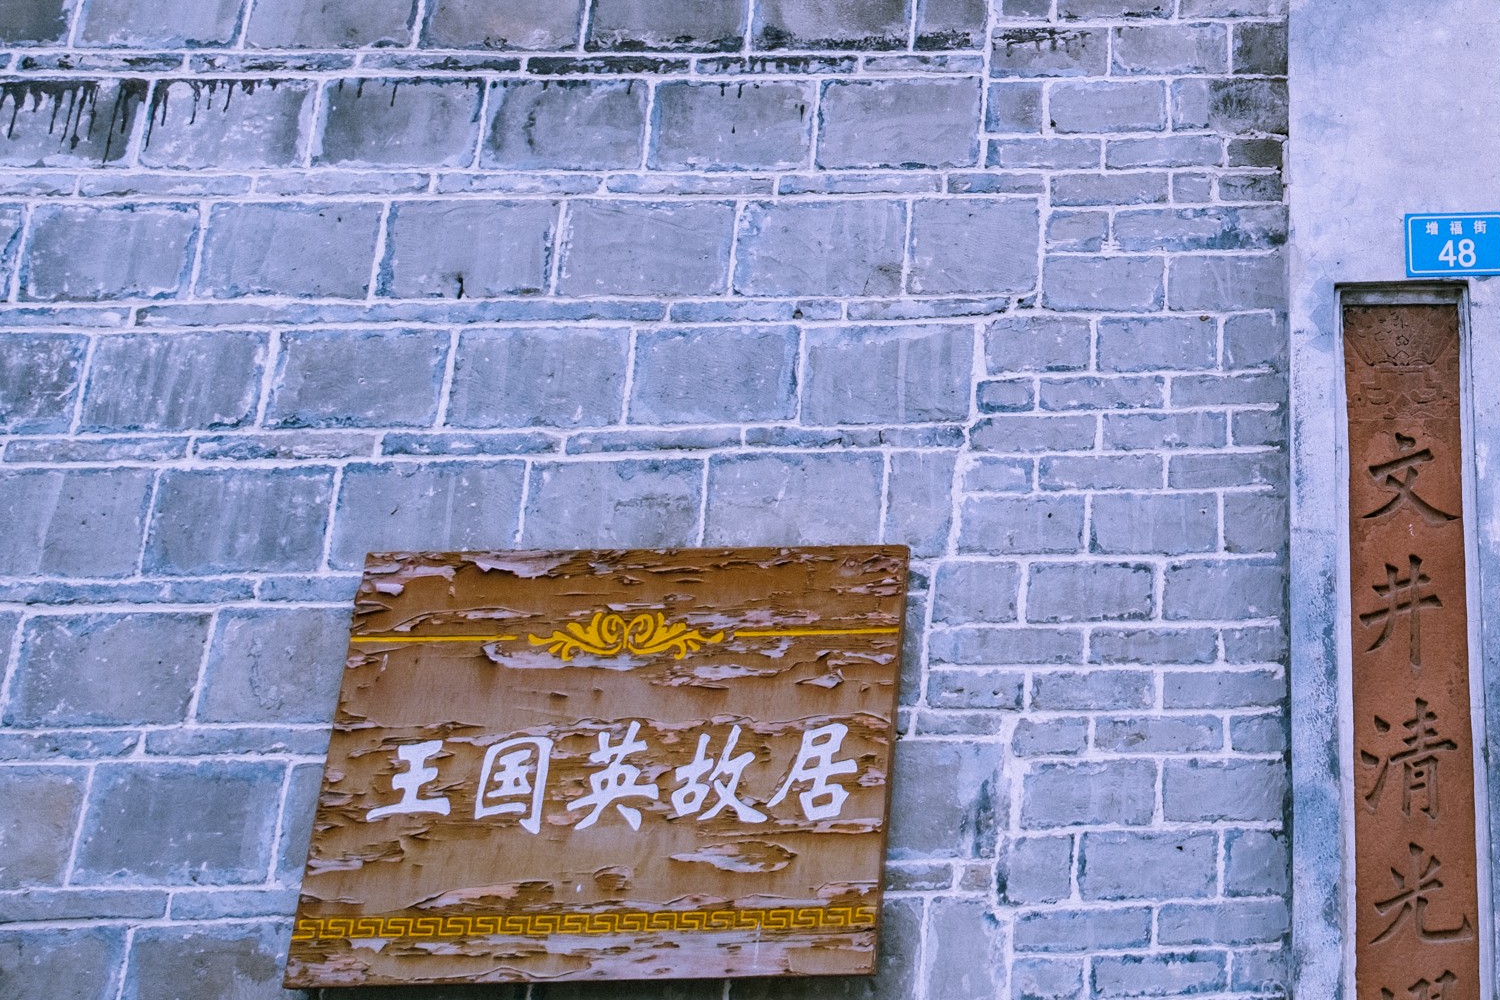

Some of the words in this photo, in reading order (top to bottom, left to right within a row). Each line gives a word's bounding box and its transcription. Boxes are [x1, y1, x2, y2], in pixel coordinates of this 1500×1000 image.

[1425, 220, 1487, 235] 增福街
[1438, 239, 1477, 268] 48
[1360, 432, 1475, 1000] 文井清光
[366, 721, 859, 835] 王国英故居
